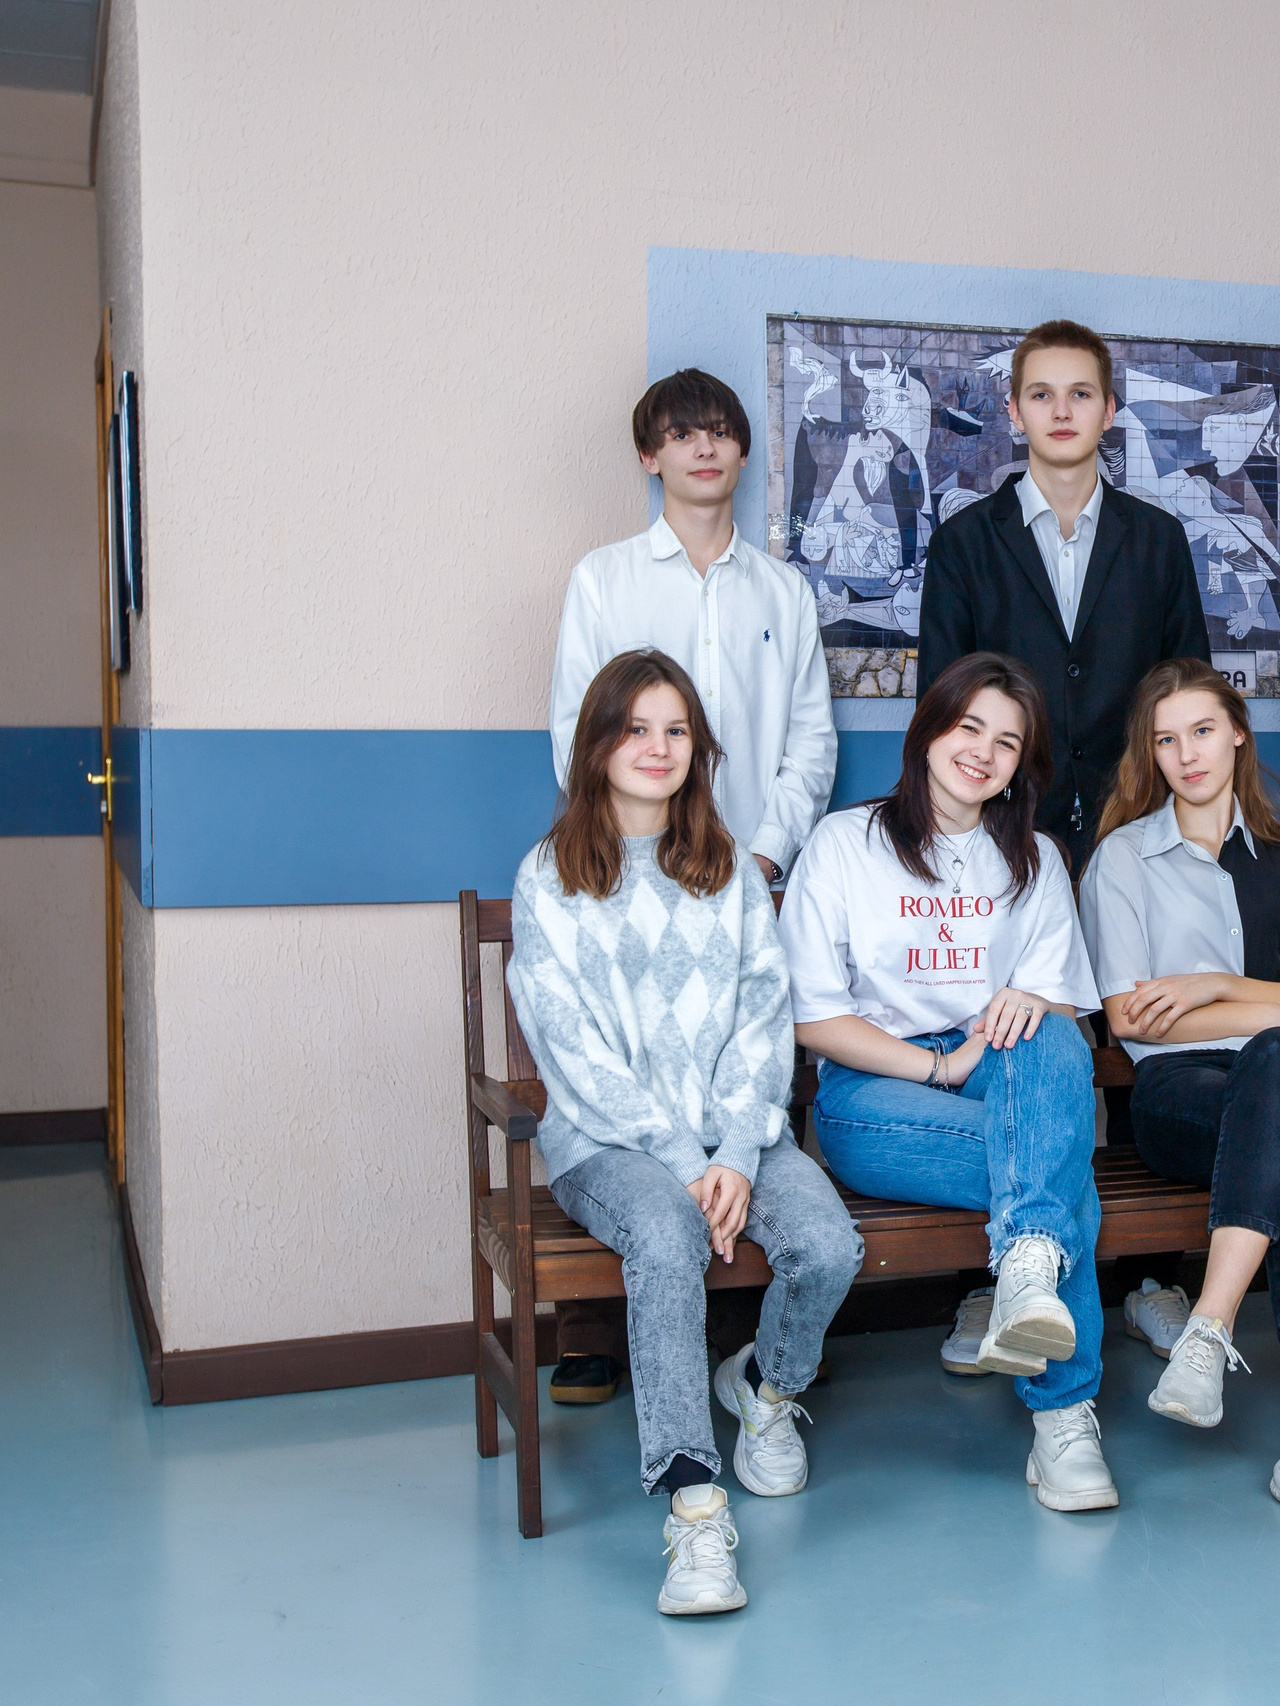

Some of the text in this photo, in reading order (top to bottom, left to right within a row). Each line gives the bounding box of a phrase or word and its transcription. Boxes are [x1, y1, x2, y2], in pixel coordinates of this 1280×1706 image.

[899, 895, 993, 918] ROMEO
[938, 922, 954, 942] &
[906, 946, 986, 974] JULIET
